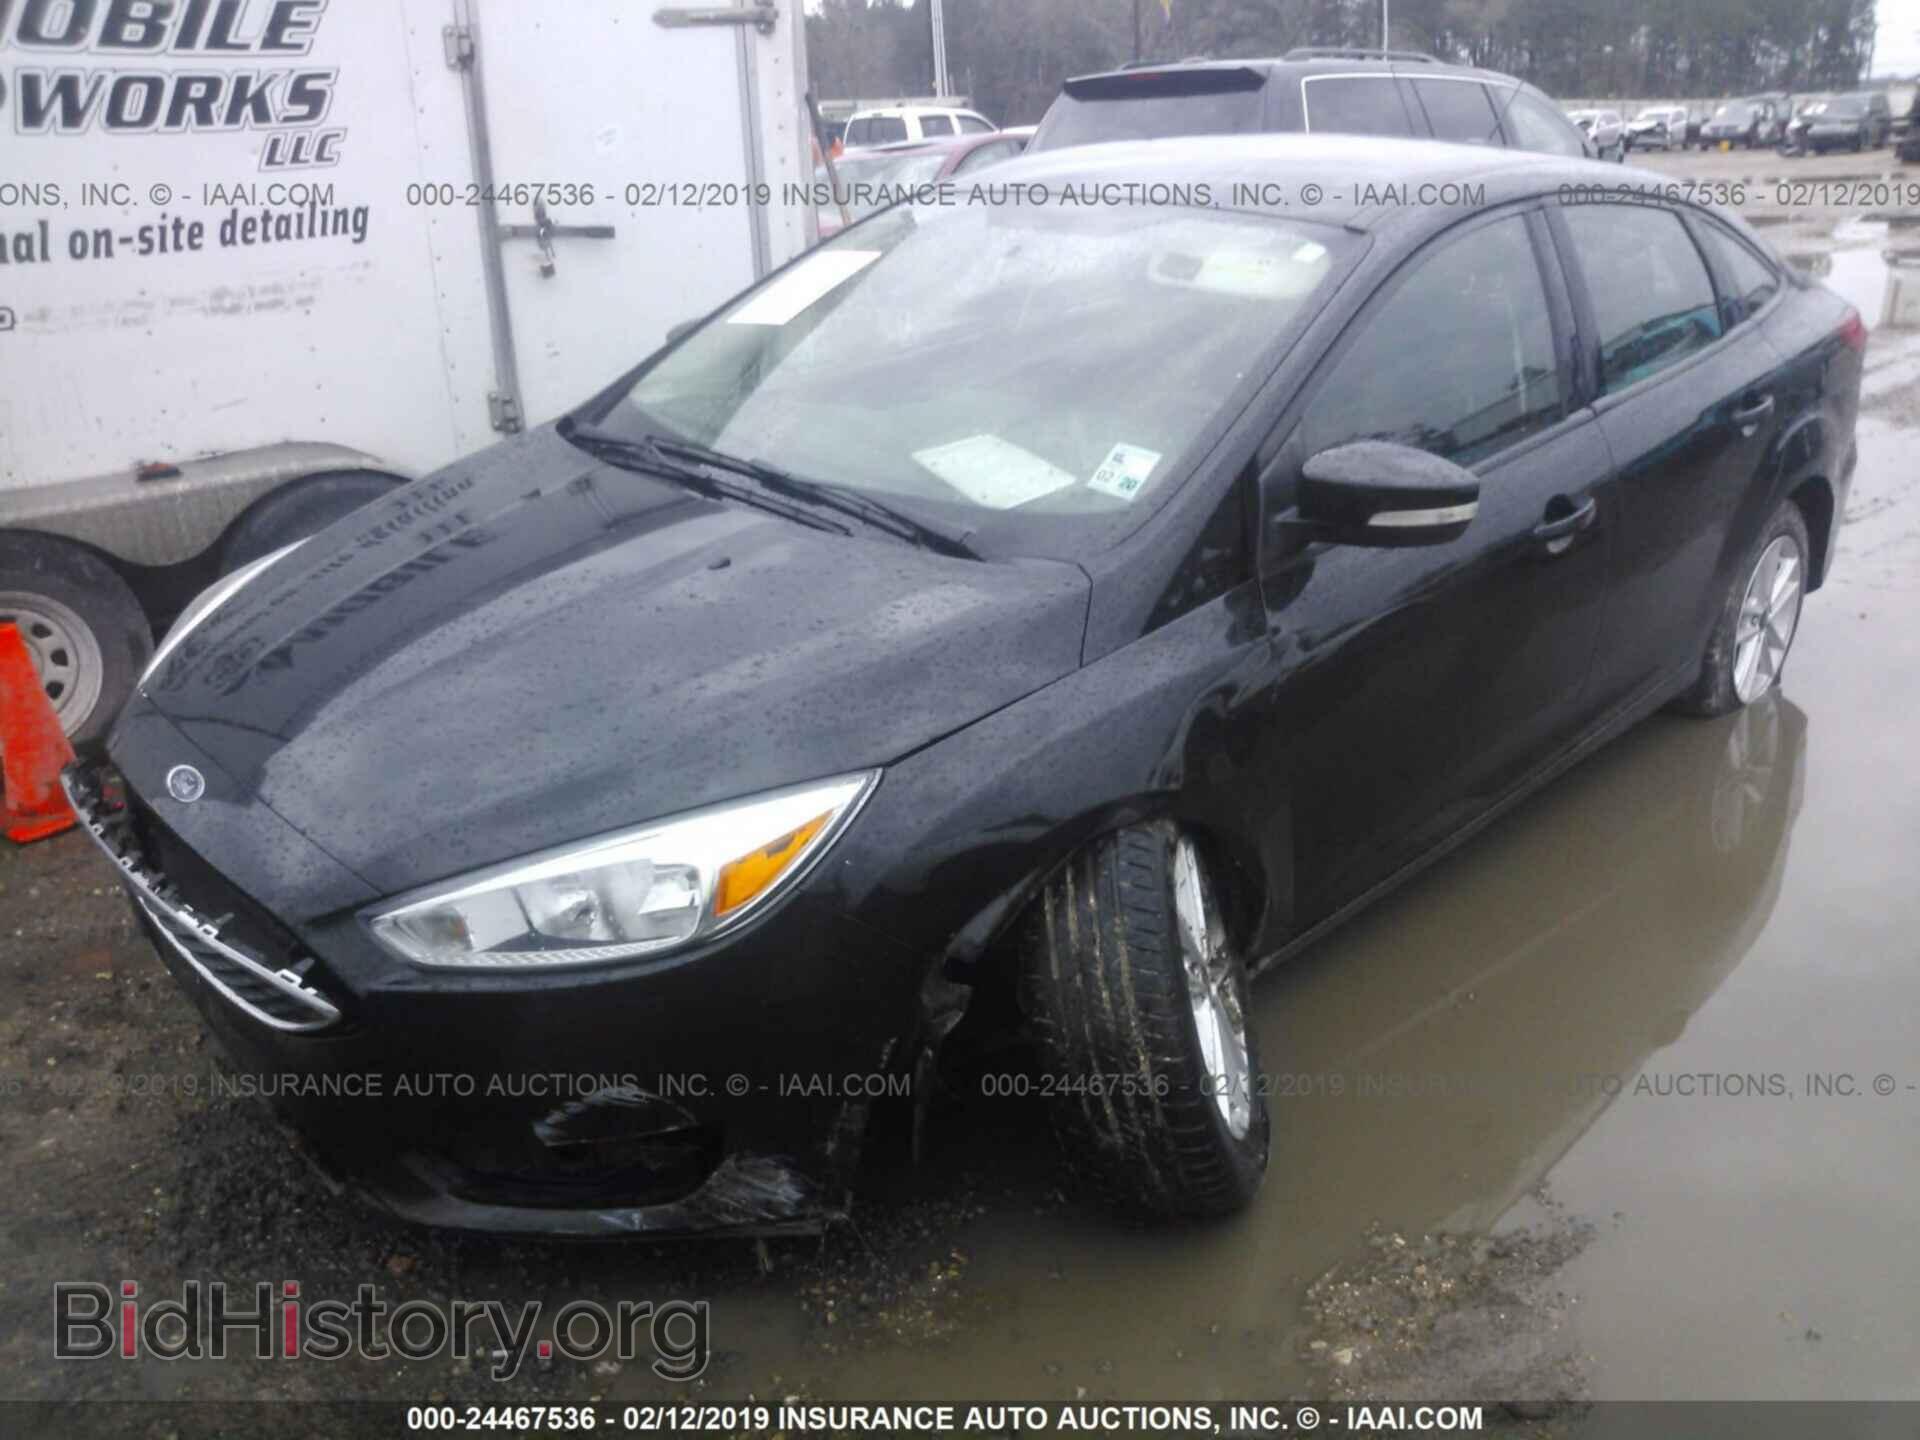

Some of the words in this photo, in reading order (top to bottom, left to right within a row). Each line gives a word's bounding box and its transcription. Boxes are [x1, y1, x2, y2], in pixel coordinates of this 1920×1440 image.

[261, 129, 345, 170] LLC
[68, 212, 204, 261] on-site
[219, 202, 370, 244] detailing
